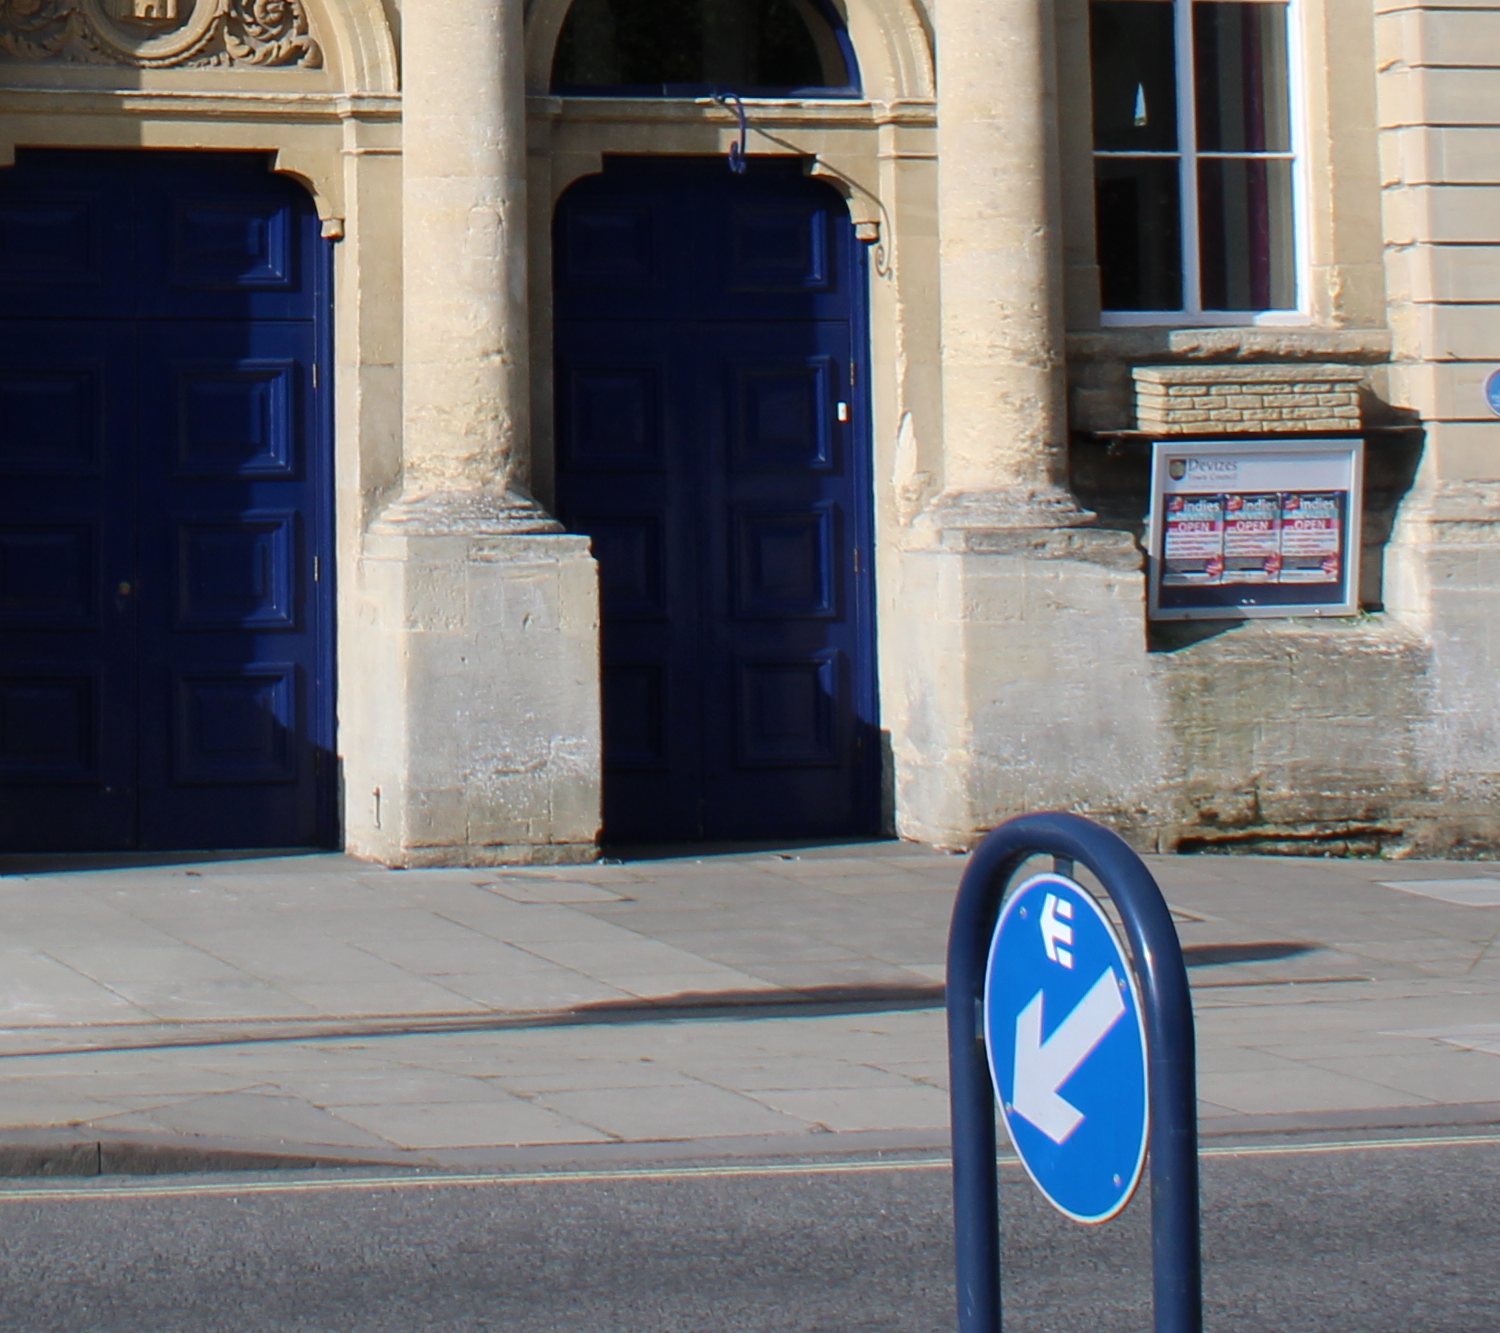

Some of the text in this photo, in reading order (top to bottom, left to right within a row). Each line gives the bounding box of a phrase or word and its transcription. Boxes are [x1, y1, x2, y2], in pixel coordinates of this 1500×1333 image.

[1187, 458, 1238, 472] Devizes
[1183, 499, 1220, 513] indies
[1242, 499, 1278, 512] indies
[1299, 497, 1336, 510] indies
[1178, 521, 1210, 532] OPEN
[1236, 520, 1269, 531] OPEN
[1294, 519, 1326, 530] OPEN
